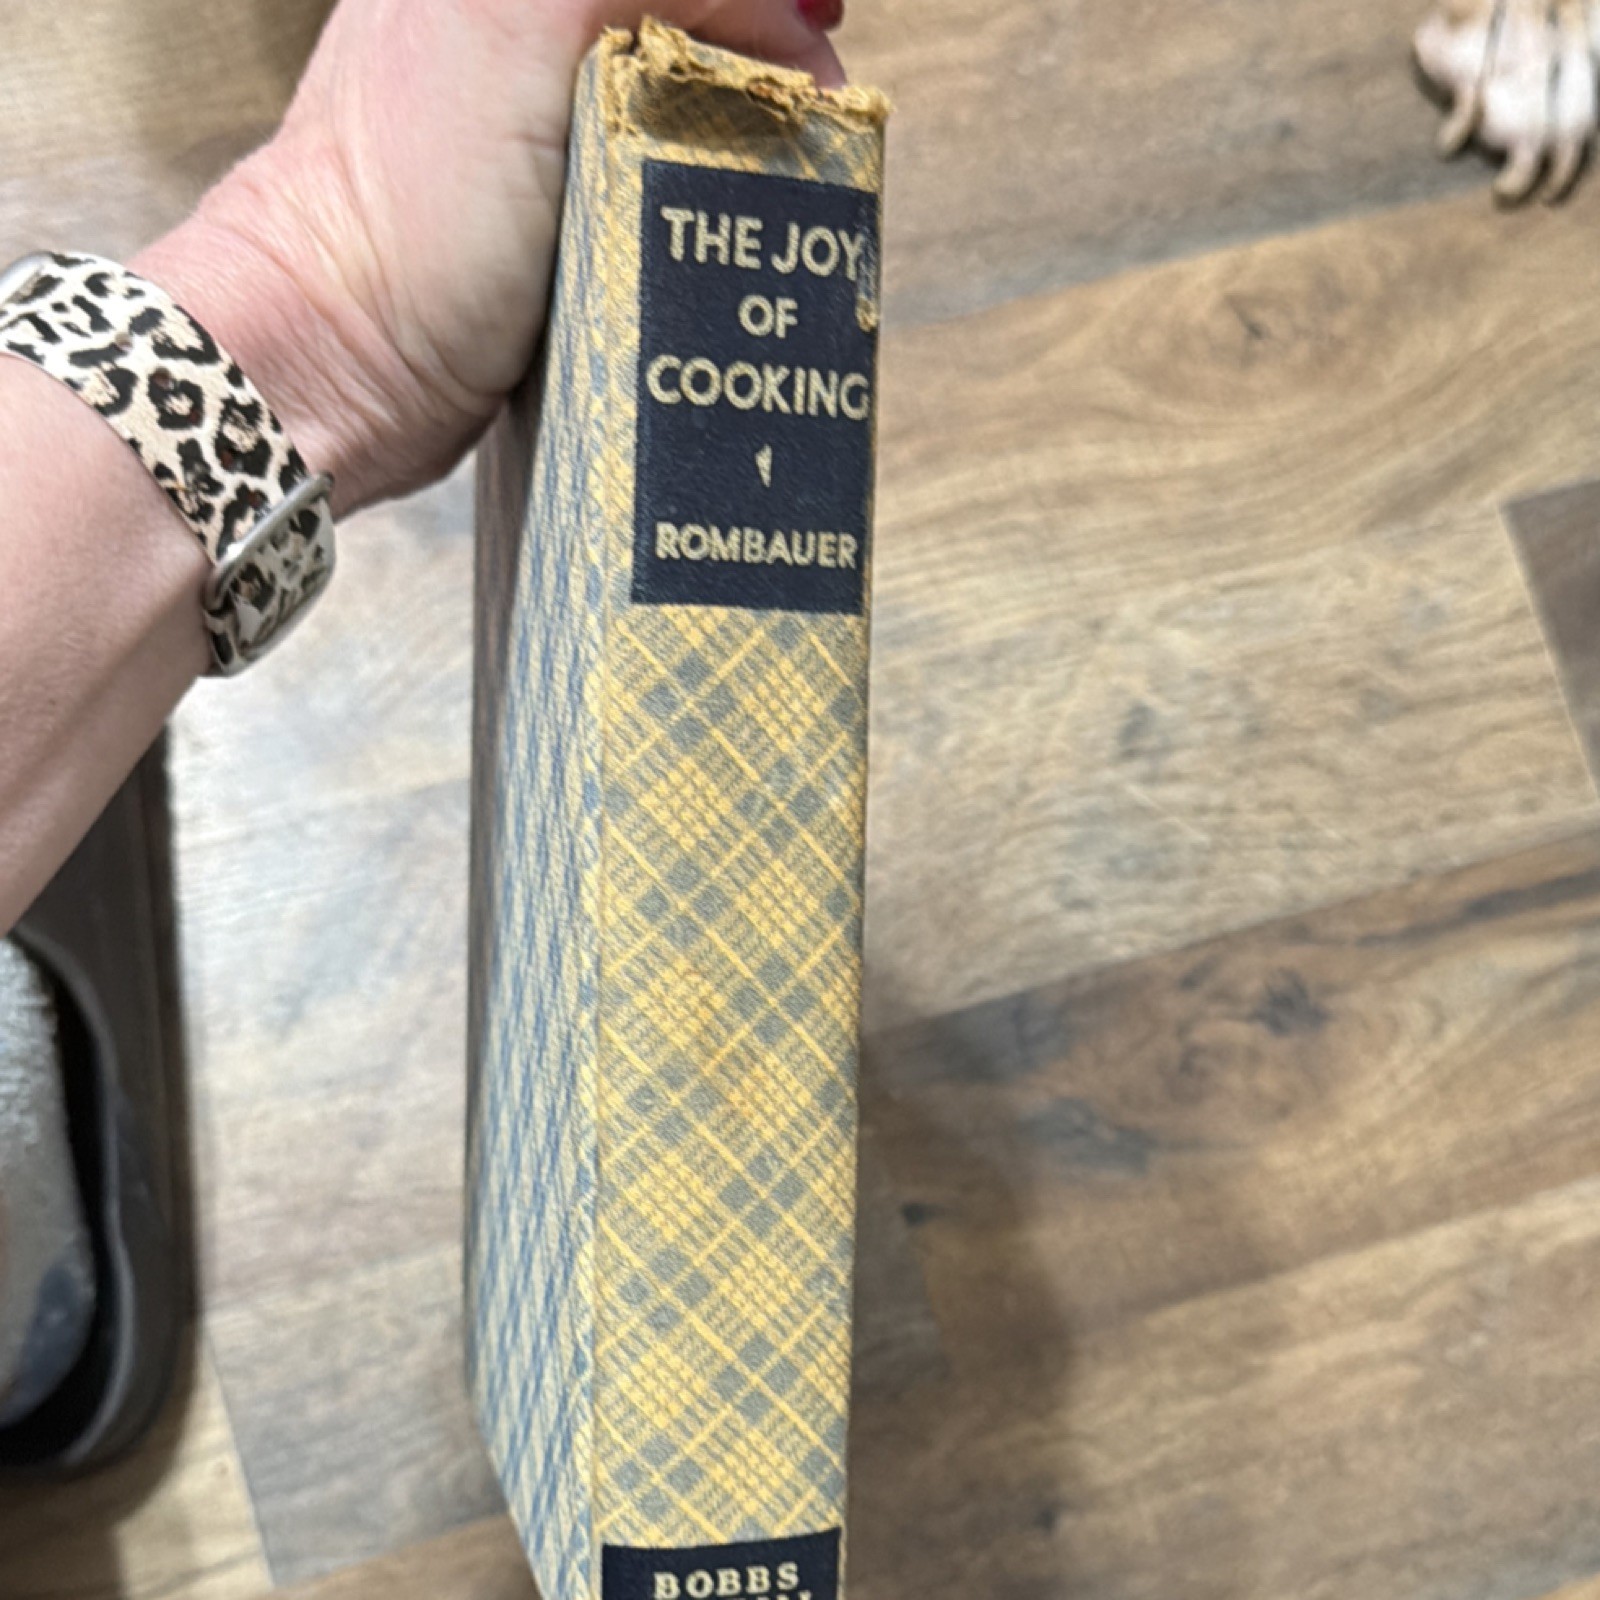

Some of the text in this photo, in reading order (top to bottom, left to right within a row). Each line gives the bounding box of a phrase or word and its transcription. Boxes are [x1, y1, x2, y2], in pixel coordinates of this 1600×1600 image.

[661, 207, 864, 281] THE JOY
[738, 295, 798, 338] OF
[646, 354, 869, 420] COOKING
[655, 521, 858, 569] ROMBAUER
[653, 1561, 799, 1600] BOBBS
